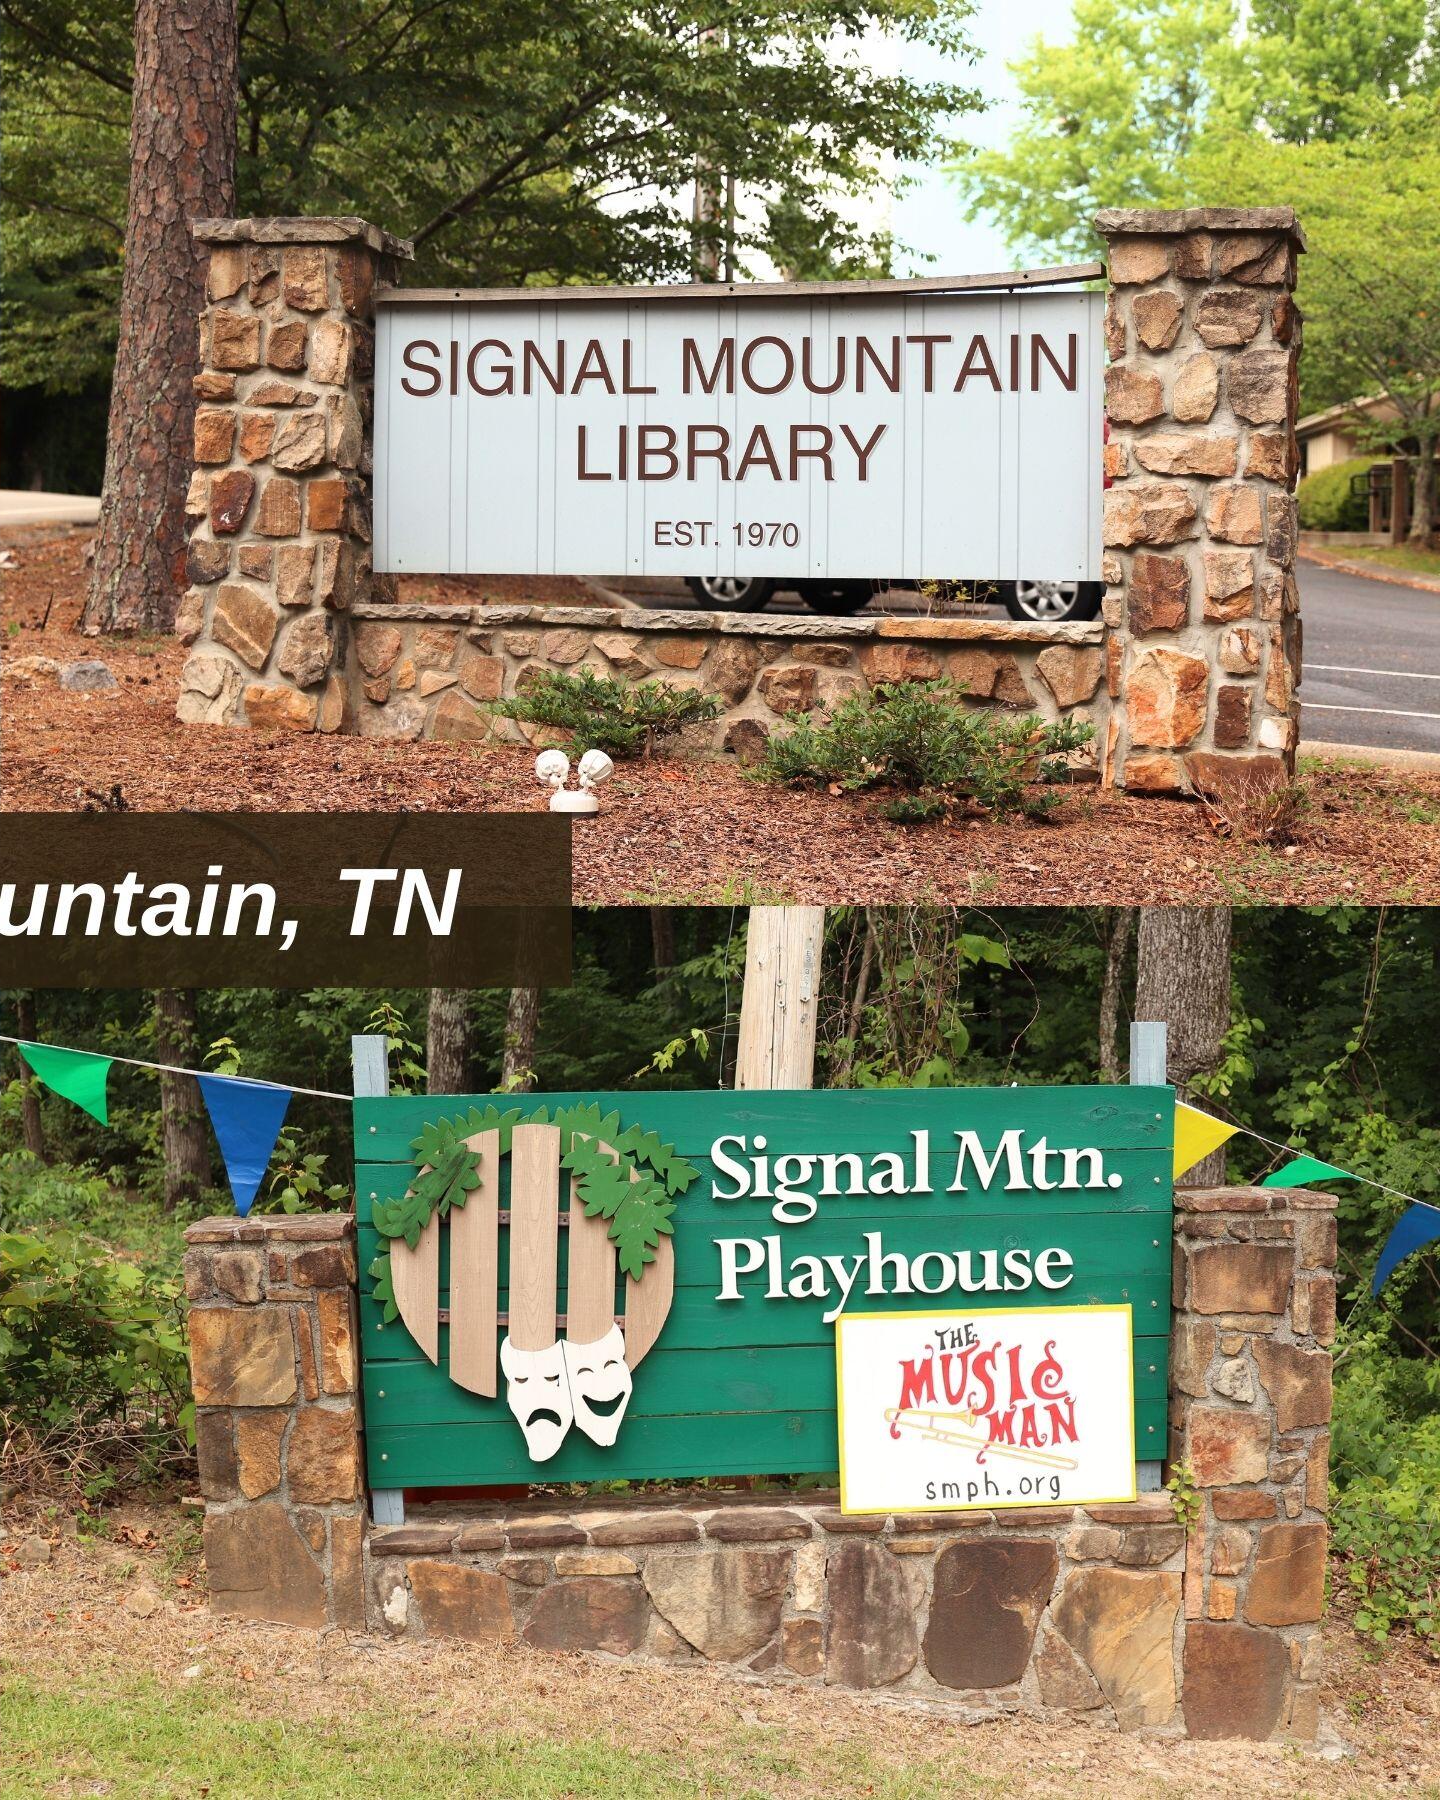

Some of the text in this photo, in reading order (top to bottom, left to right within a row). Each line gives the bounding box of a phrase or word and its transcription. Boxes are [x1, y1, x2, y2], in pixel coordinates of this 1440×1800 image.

[400, 333, 1079, 397] SIGNAL MOUNTAIN
[577, 423, 888, 483] LIBRARY
[654, 521, 800, 548] EST. 1970
[710, 1128, 1123, 1224] Signal Mtn.
[713, 1231, 1075, 1324] Playhouse
[934, 1323, 977, 1350] THE
[890, 1339, 1070, 1440] MUSIC
[976, 1394, 1081, 1465] MAN
[926, 1471, 1061, 1502] smph.org
